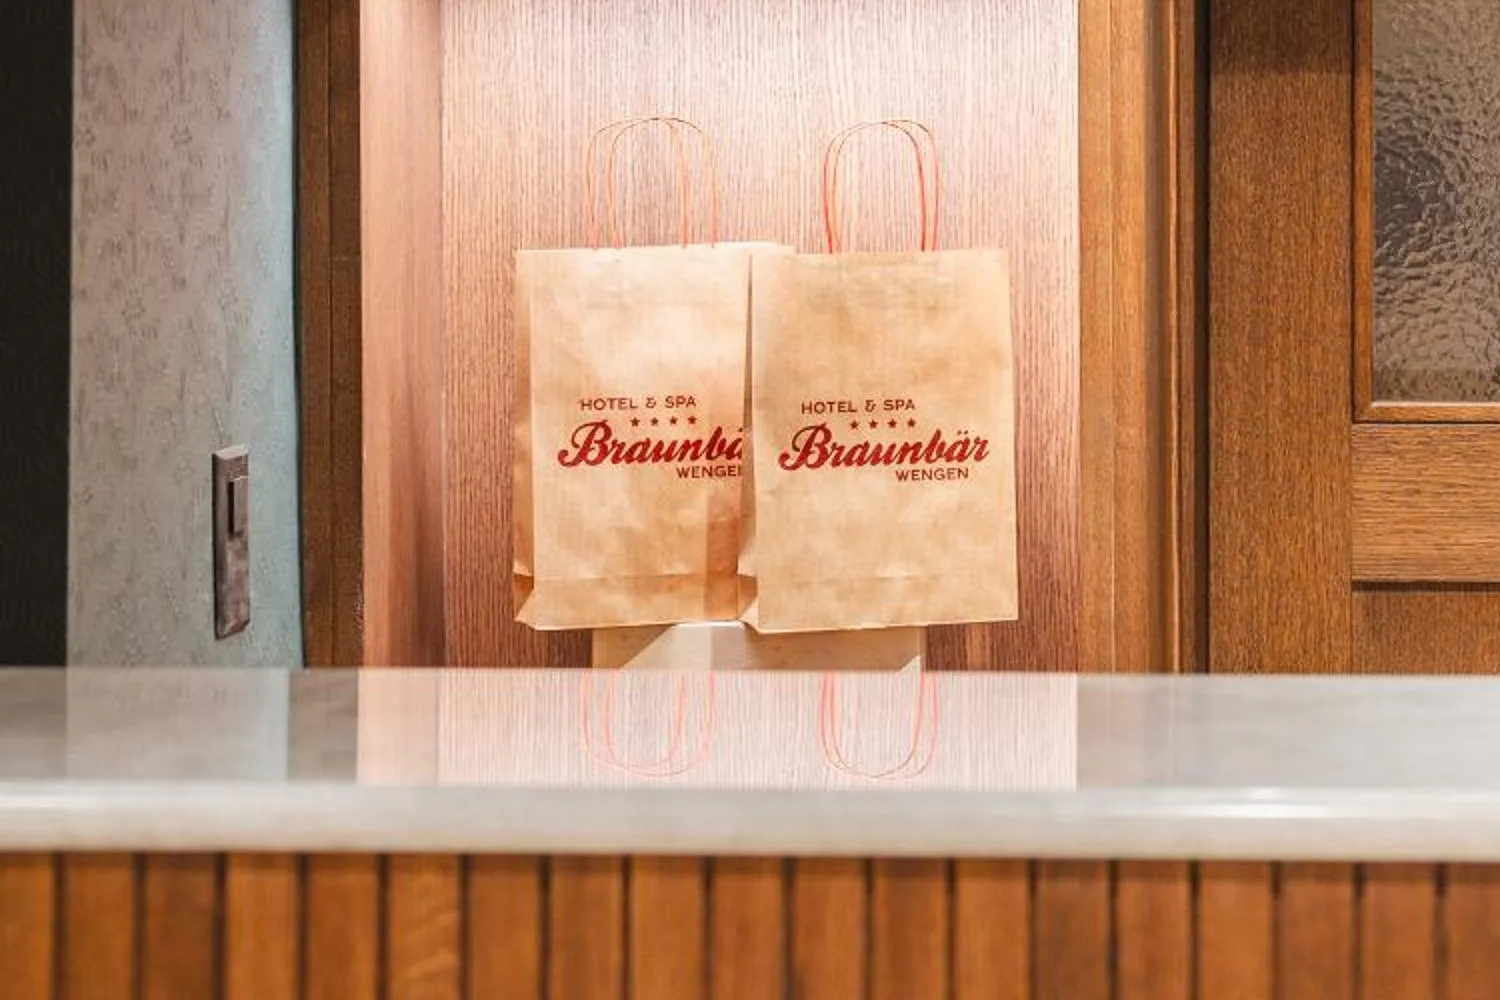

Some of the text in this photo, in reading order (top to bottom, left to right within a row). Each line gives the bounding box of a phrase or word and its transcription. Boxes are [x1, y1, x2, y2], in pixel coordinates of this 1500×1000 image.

[580, 395, 697, 411] HOTEL & SPA
[801, 399, 916, 414] HOTEL & SPA
[778, 422, 990, 470] Braunbär
[676, 464, 742, 479] WENGE
[895, 467, 969, 481] WENGEN
